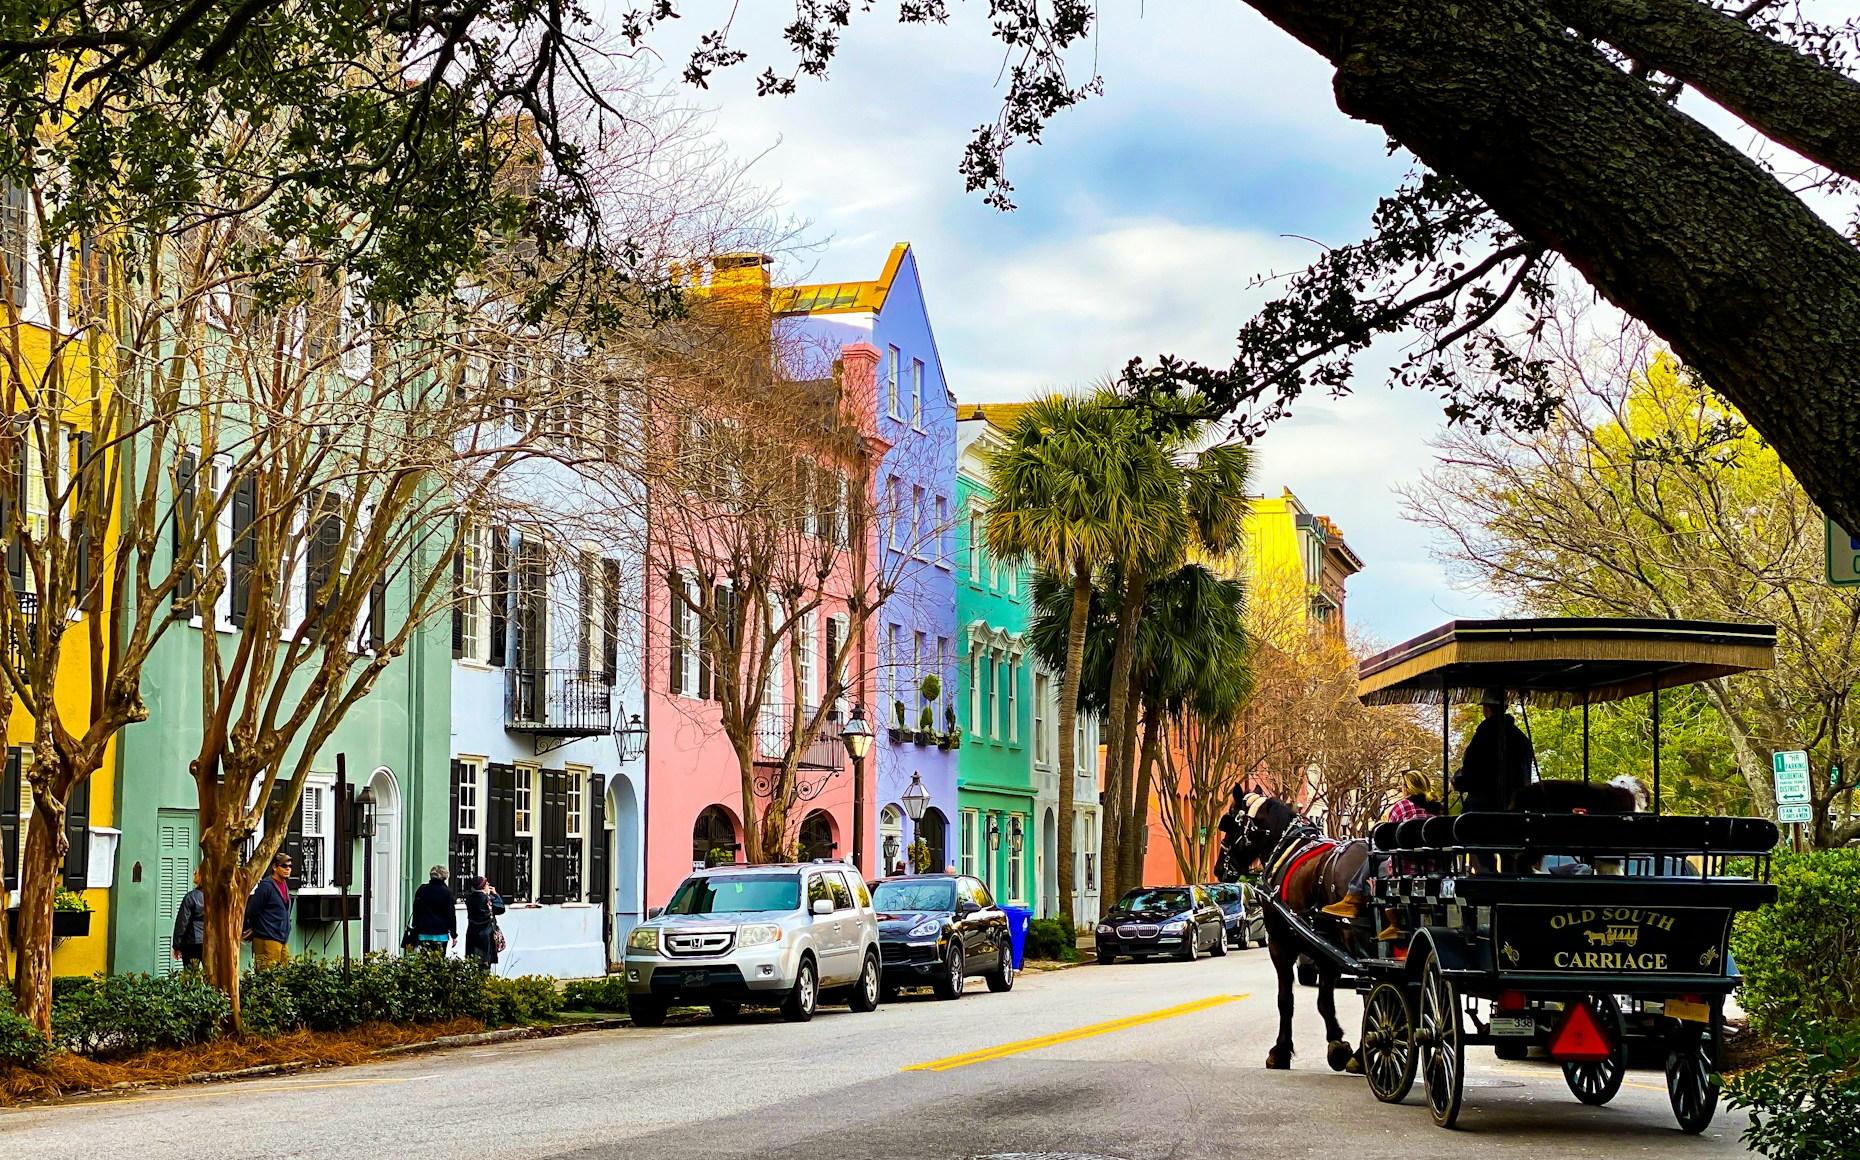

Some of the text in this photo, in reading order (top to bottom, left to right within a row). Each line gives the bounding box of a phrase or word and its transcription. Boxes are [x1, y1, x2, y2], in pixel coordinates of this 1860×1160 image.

[1779, 772, 1805, 780] RESIDENTIAL
[1779, 785, 1800, 793] DISTRICT
[1550, 908, 1675, 931] OLD SOUTH
[1554, 952, 1668, 970] CARRIAGE
